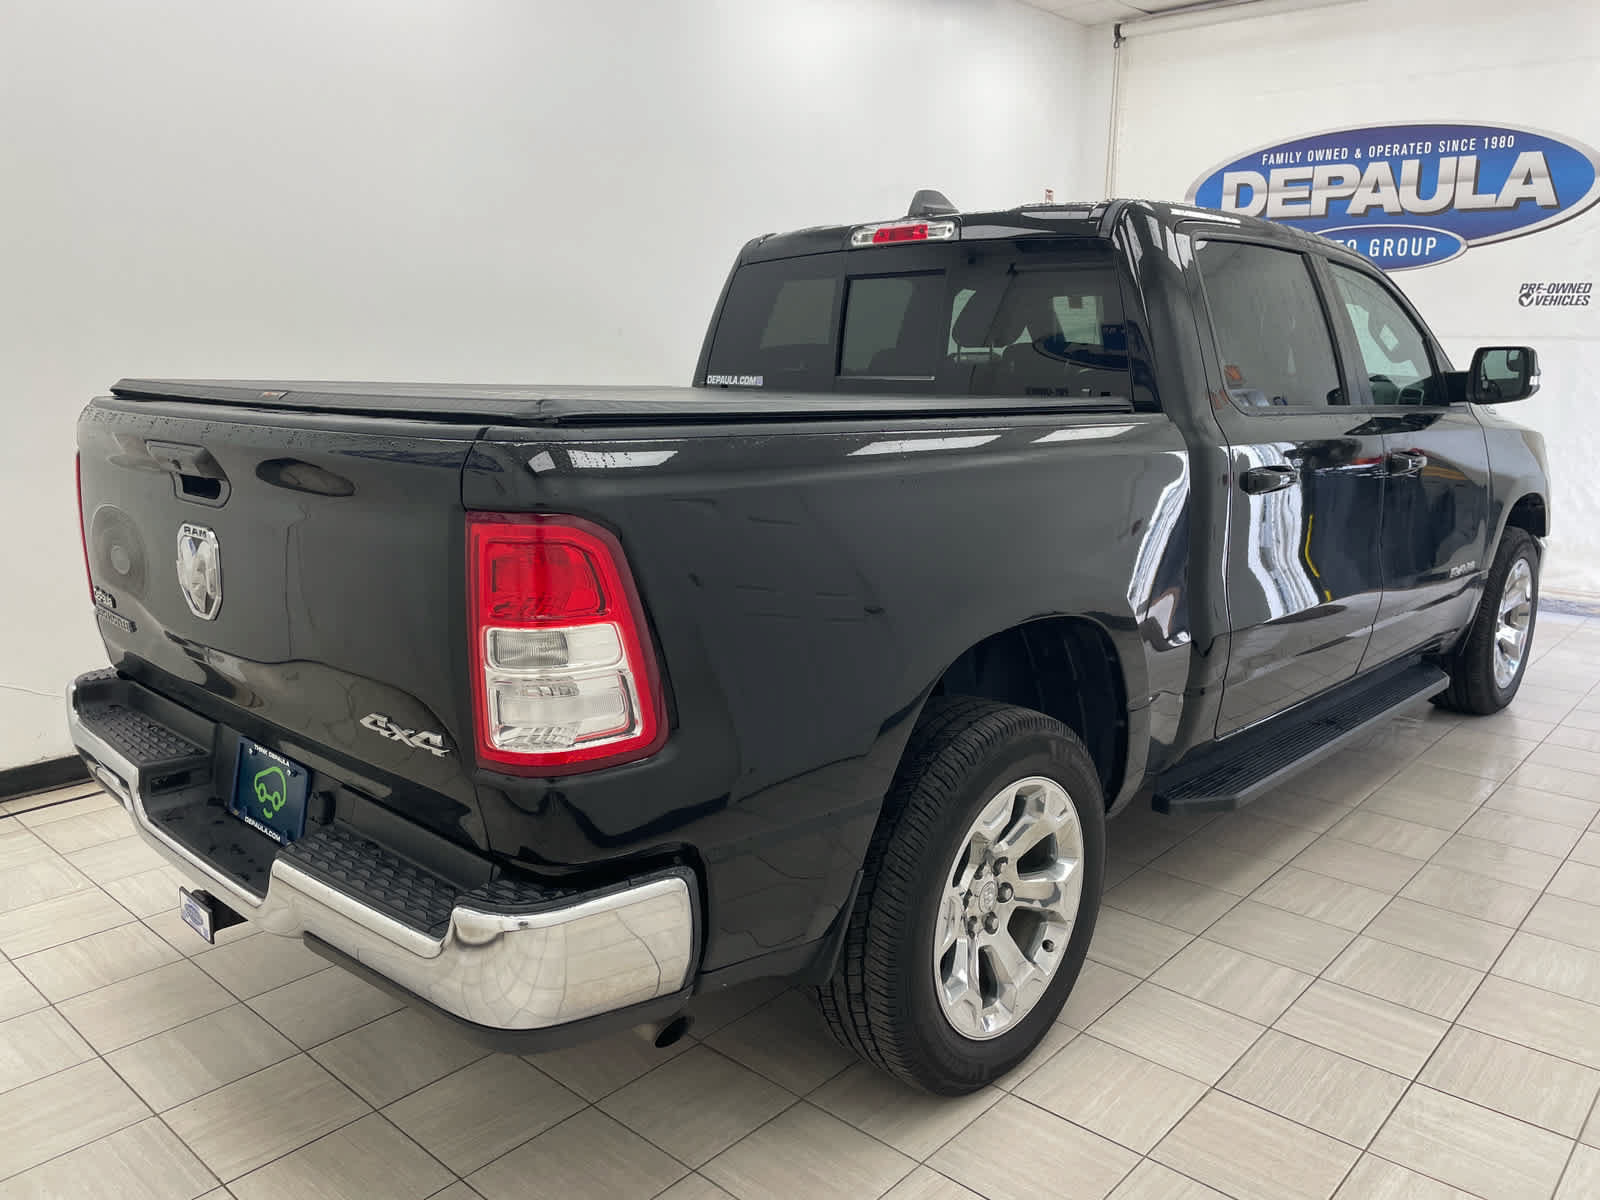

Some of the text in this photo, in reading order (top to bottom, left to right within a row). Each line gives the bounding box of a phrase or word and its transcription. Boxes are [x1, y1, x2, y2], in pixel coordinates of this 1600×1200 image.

[1262, 135, 1515, 166] FAMILY OWNED & OPERATED SINCE 1980
[1220, 151, 1561, 219] DEPAULA
[1368, 237, 1437, 257] GROUP
[1519, 282, 1592, 294] PRE-OWNED
[1535, 295, 1591, 306] VEHICLES
[707, 375, 757, 385] DEPAULA.COM
[183, 526, 208, 538] RAM
[244, 816, 281, 842] DEPAULA.COM
